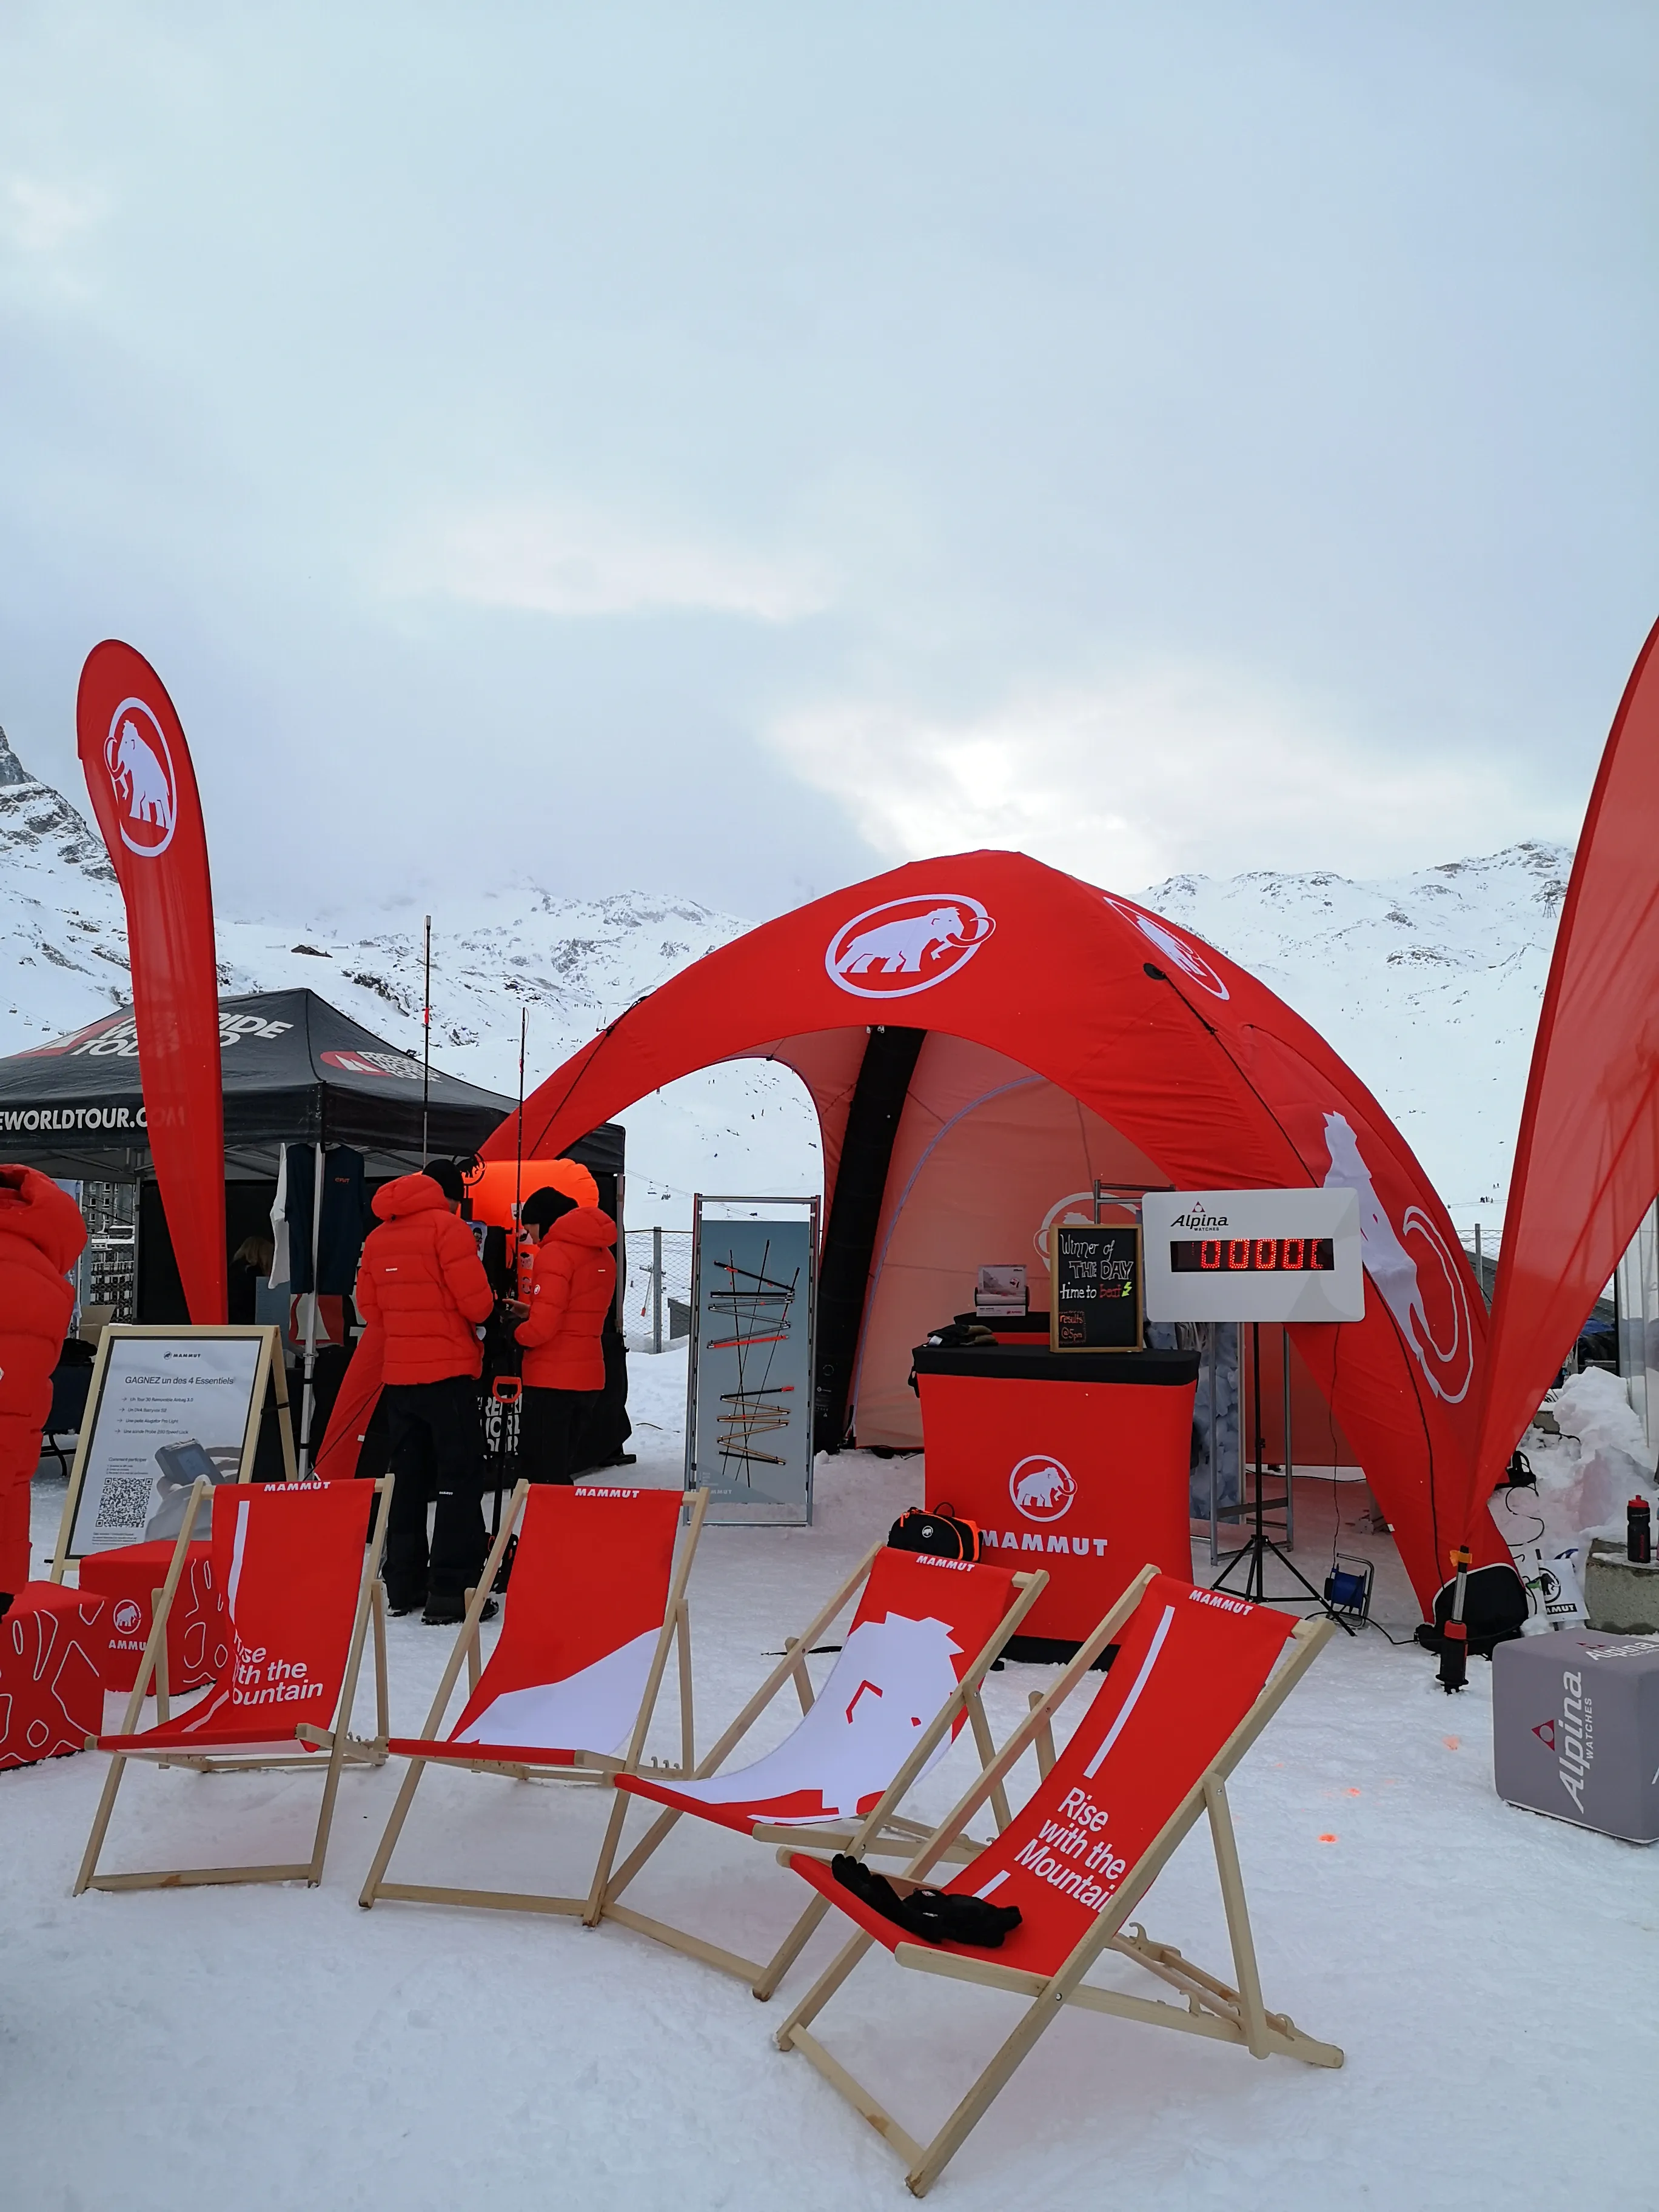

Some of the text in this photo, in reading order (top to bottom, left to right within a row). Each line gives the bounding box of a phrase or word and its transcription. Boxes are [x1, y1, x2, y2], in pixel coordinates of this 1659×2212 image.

[1170, 1215, 1229, 1229] Alpina
[1060, 1234, 1115, 1261] Winner of
[1068, 1260, 1134, 1280] THE DAY
[1060, 1281, 1121, 1299] time to beat
[1059, 1315, 1084, 1324] results
[264, 1481, 331, 1492] MAMMUT
[575, 1488, 640, 1498] MAMMUT
[982, 1530, 1108, 1557] MAMMUT
[916, 1555, 975, 1572] MAMMUT
[1188, 1590, 1254, 1615] MAMMUT
[109, 1639, 147, 1651] AMMU
[267, 1659, 307, 1681] the
[233, 1679, 323, 1705] ountain
[1584, 1697, 1594, 1759] WATCHES
[1558, 1671, 1590, 1814] Alpina
[1057, 1787, 1108, 1832] Rise
[1038, 1819, 1126, 1880] with the
